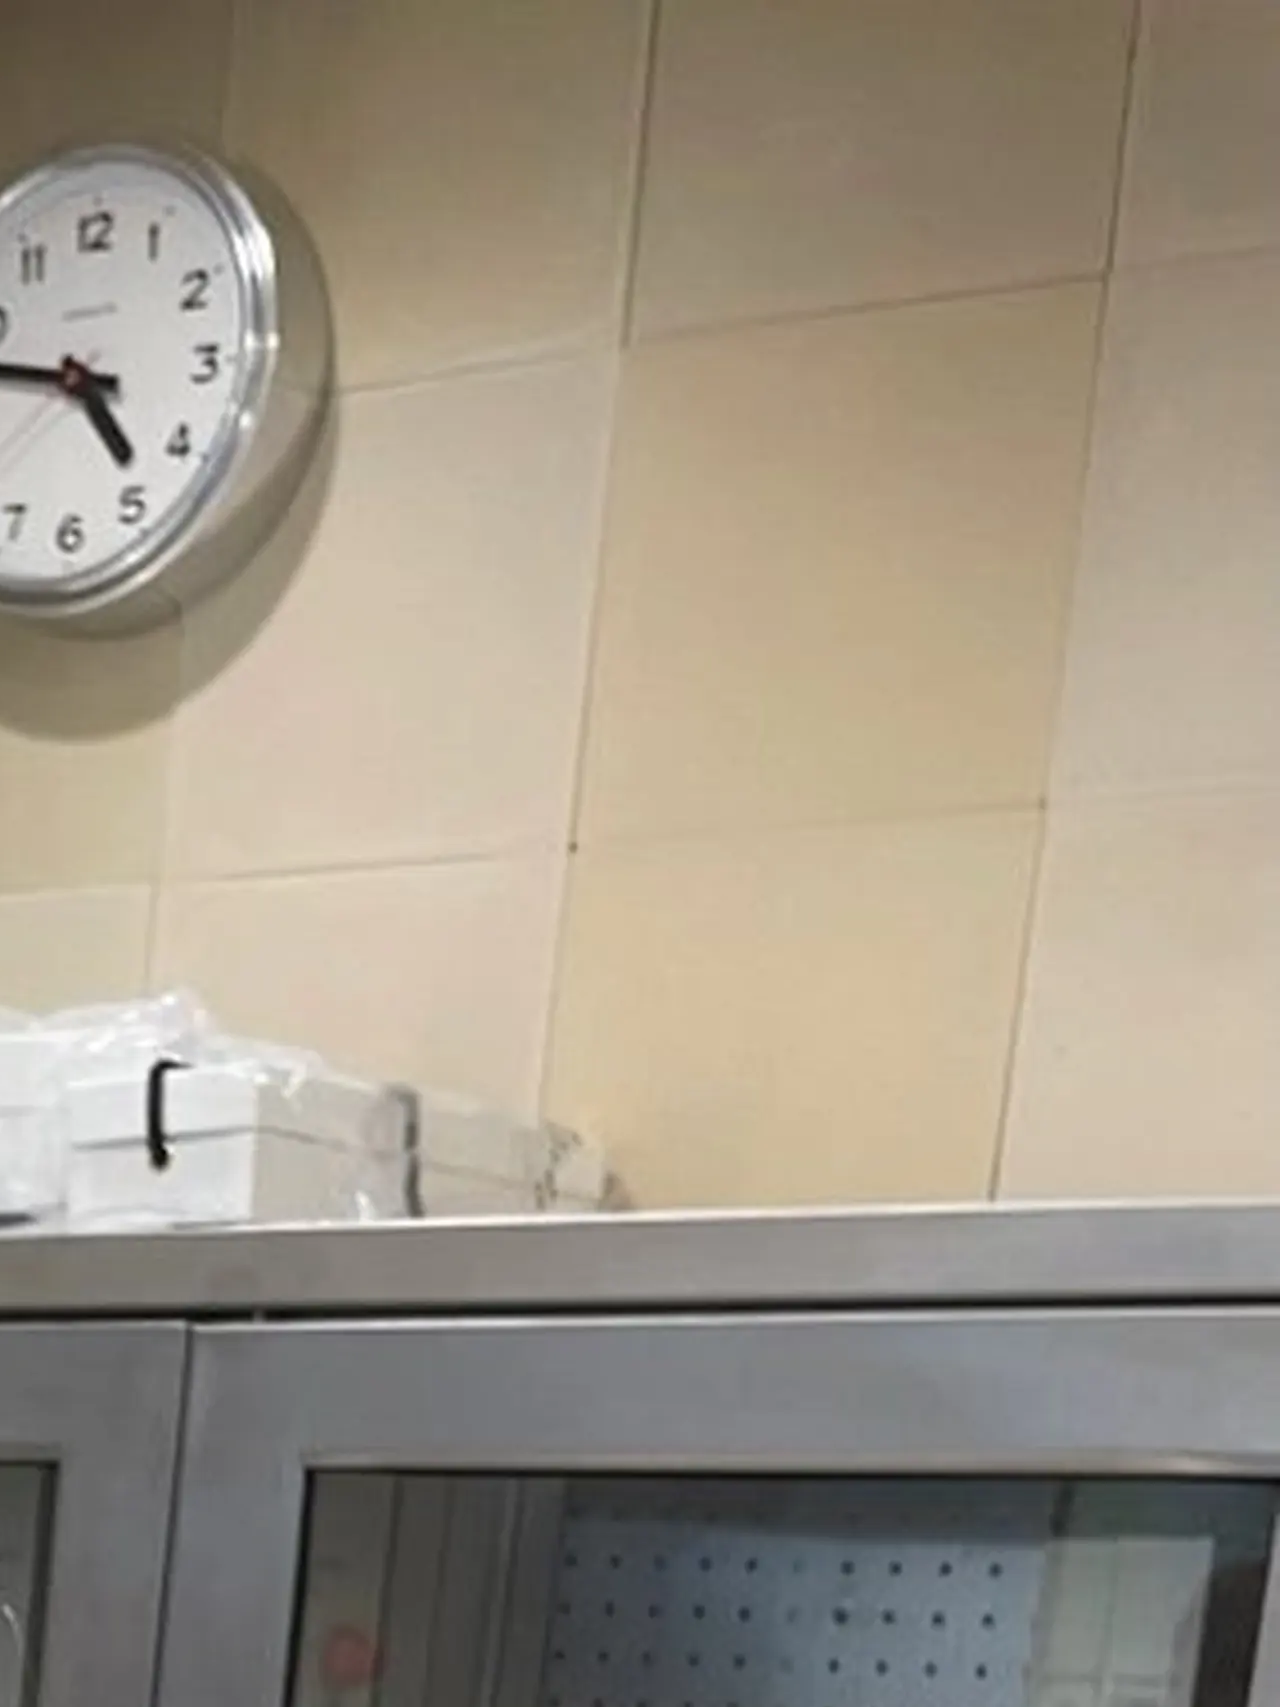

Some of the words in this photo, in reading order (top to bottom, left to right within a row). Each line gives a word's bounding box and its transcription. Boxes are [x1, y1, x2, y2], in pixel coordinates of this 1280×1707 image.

[78, 211, 114, 251] 12
[147, 223, 160, 261] 1
[21, 245, 45, 284] 11
[181, 269, 209, 310] 2
[191, 343, 219, 384] 3
[166, 423, 191, 458] 4
[4, 503, 27, 541] 7
[119, 486, 146, 524] 5
[56, 515, 83, 553] 6
